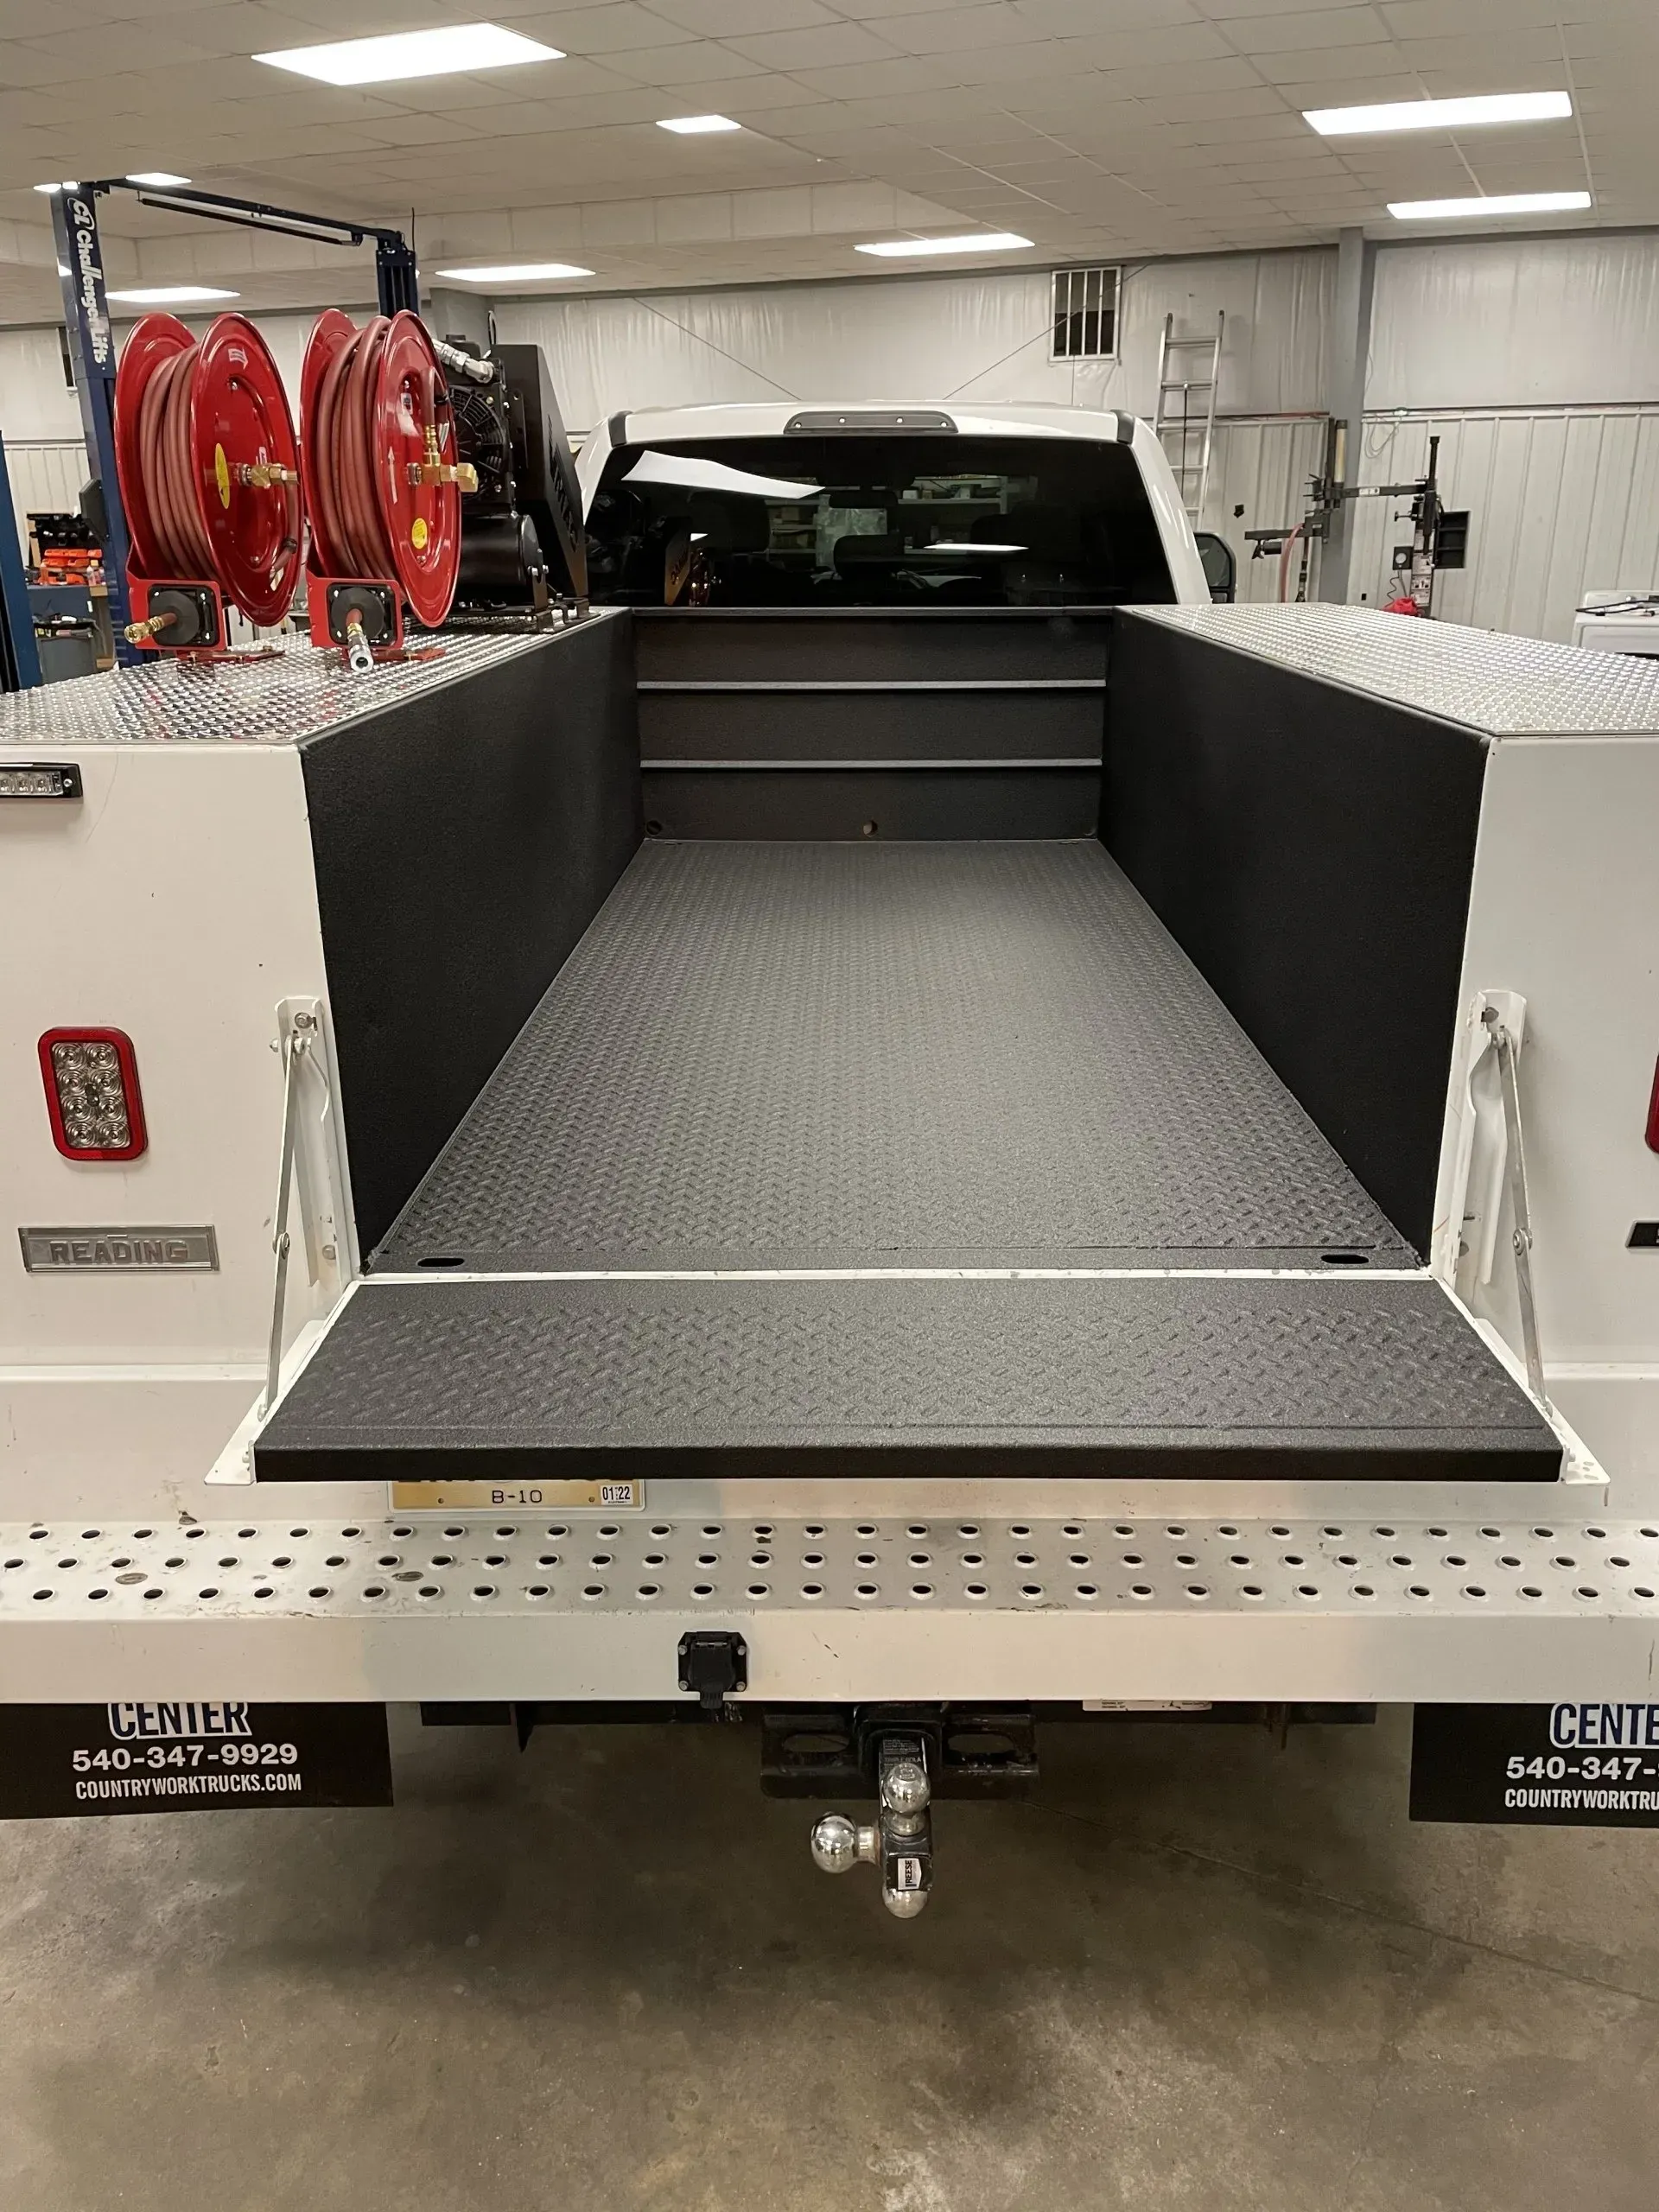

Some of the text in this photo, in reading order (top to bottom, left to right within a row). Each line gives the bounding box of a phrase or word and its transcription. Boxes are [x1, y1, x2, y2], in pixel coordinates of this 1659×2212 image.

[49, 1240, 188, 1264] READING
[492, 1490, 543, 1503] B-10
[602, 1486, 613, 1500] 01
[618, 1486, 631, 1500] 22
[108, 1702, 252, 1740] CENTER
[73, 1744, 298, 1771] 540-347-9929
[1506, 1756, 1659, 1780] 540-347-
[75, 1773, 302, 1800] COUNTRYWORKTRUCKS.COM
